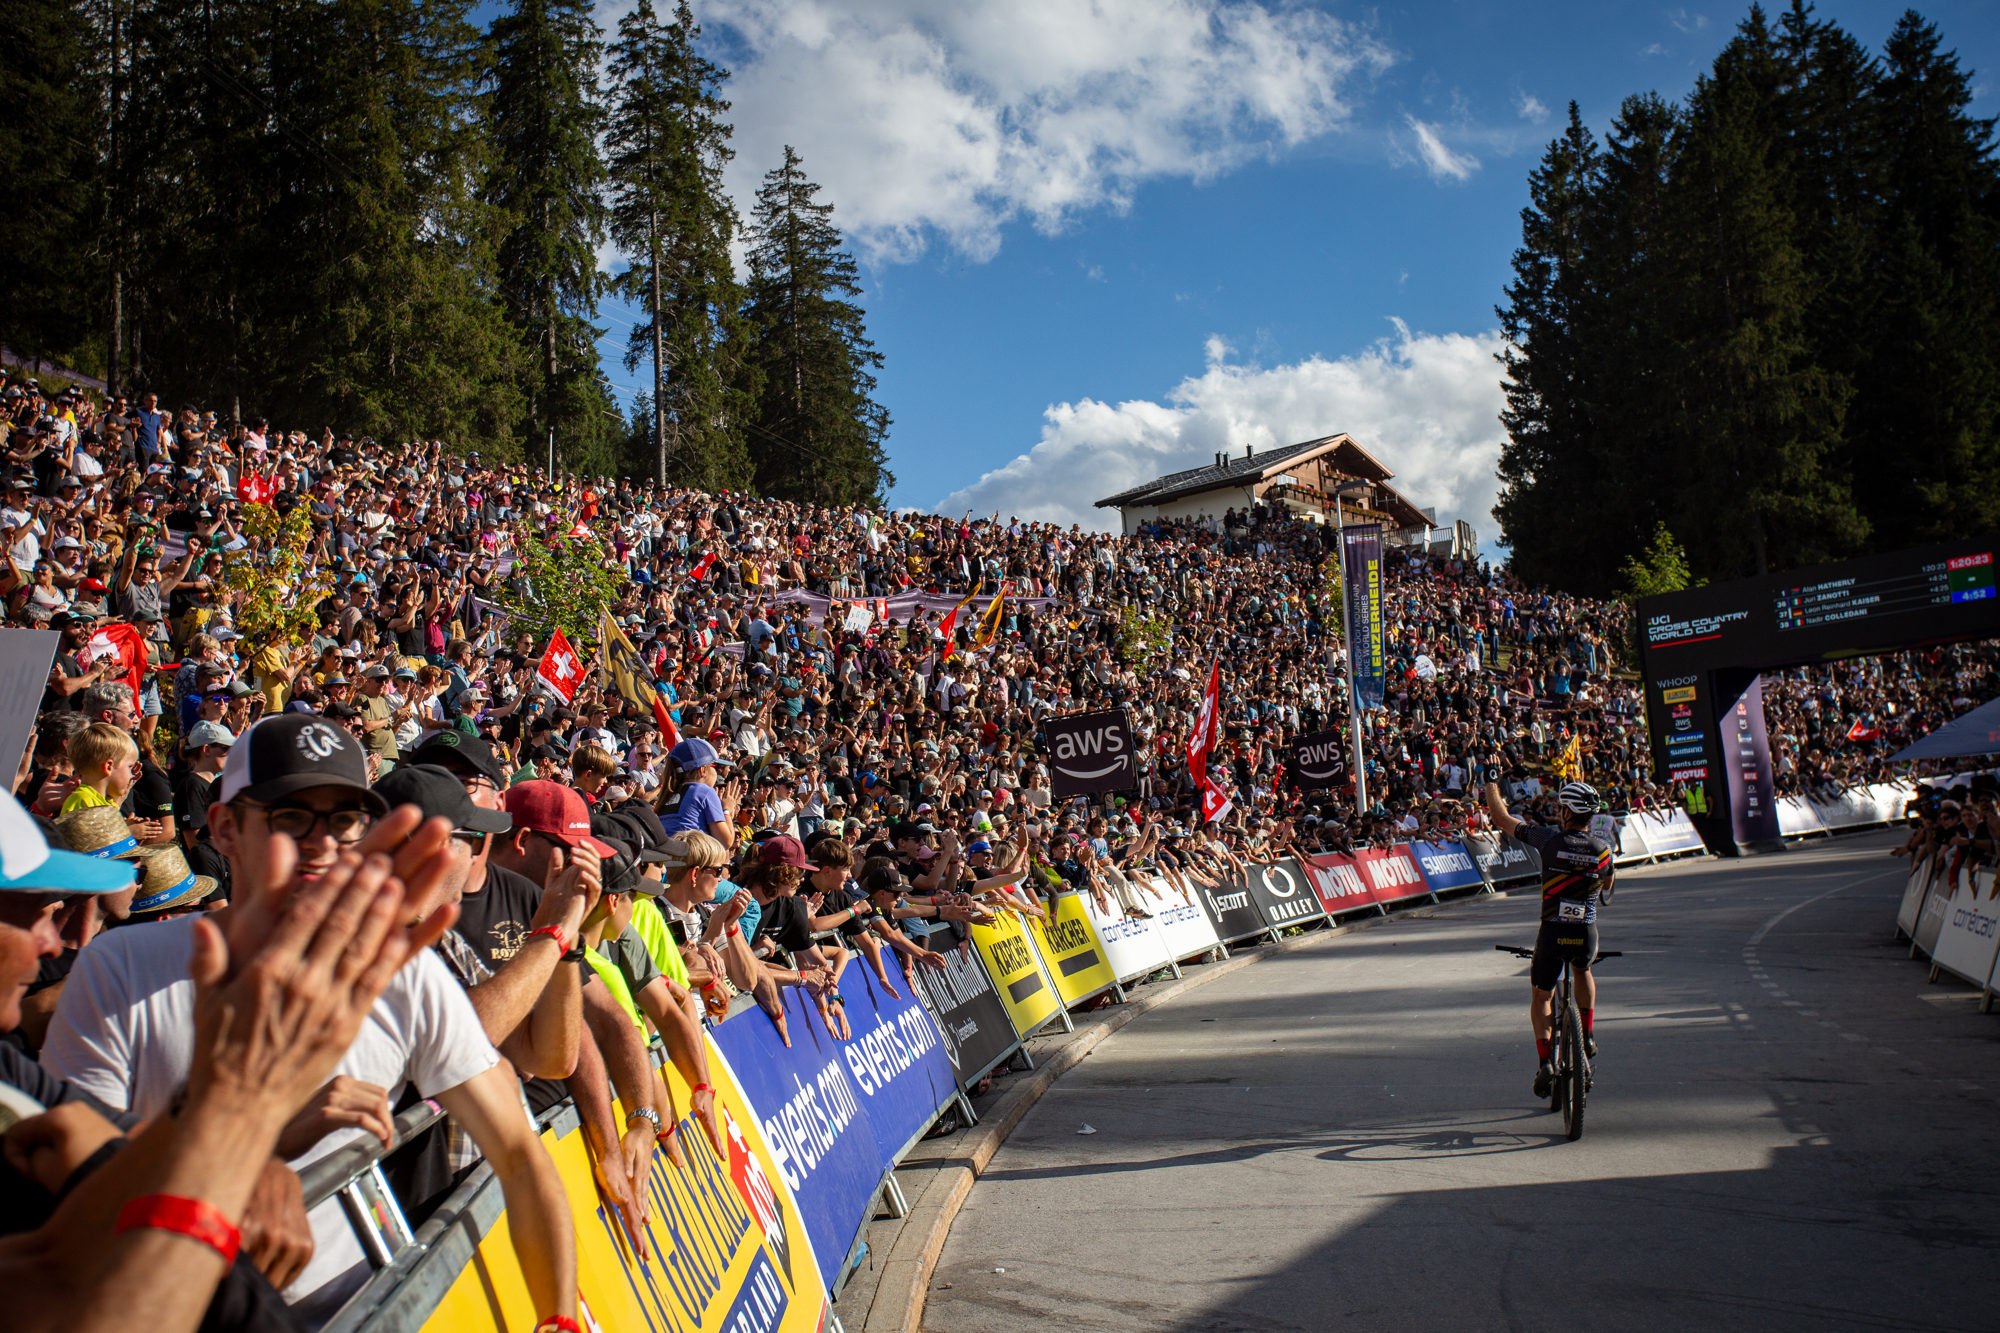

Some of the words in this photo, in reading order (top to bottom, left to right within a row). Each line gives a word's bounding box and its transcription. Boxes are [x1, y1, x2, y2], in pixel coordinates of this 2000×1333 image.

[1950, 554, 1989, 569] 1:20:23
[1817, 577, 1856, 591] HATHERLY
[1816, 590, 1850, 602] ZANOTTI
[1851, 595, 1881, 606] KAISER
[1962, 589, 1987, 601] 4:52
[1360, 594, 1369, 624] SERIES
[1367, 558, 1383, 677] LENZERHEIDE
[1824, 608, 1868, 621] COLLEDANI
[1648, 621, 1690, 635] CROSS
[1691, 610, 1749, 628] COUNTRY
[1651, 614, 1671, 626] UCI
[1361, 625, 1370, 657] WORLD
[1649, 627, 1694, 642] WORLD
[1695, 623, 1721, 635] CUP
[1363, 659, 1371, 678] BIKE
[1657, 675, 1698, 688] WHOOP
[1675, 718, 1691, 727] aws
[1056, 725, 1124, 760] aws
[1670, 746, 1703, 756] SHIMANO
[1299, 741, 1341, 766] aws
[1668, 759, 1708, 769] events.com
[1673, 768, 1706, 780] MOTUL
[1366, 855, 1421, 890] MOTUL
[1420, 852, 1473, 876] SHIMANO
[1313, 864, 1367, 900] MOTUL
[1219, 891, 1249, 912] SCOTT
[1268, 898, 1315, 922] OAKLEY
[1564, 906, 1581, 916] 26
[919, 960, 958, 1015] BIKE
[941, 948, 990, 1005] KINGDOM
[845, 1004, 937, 1097] events.com
[765, 1058, 858, 1192] events.com
[743, 1150, 786, 1268] AOP
